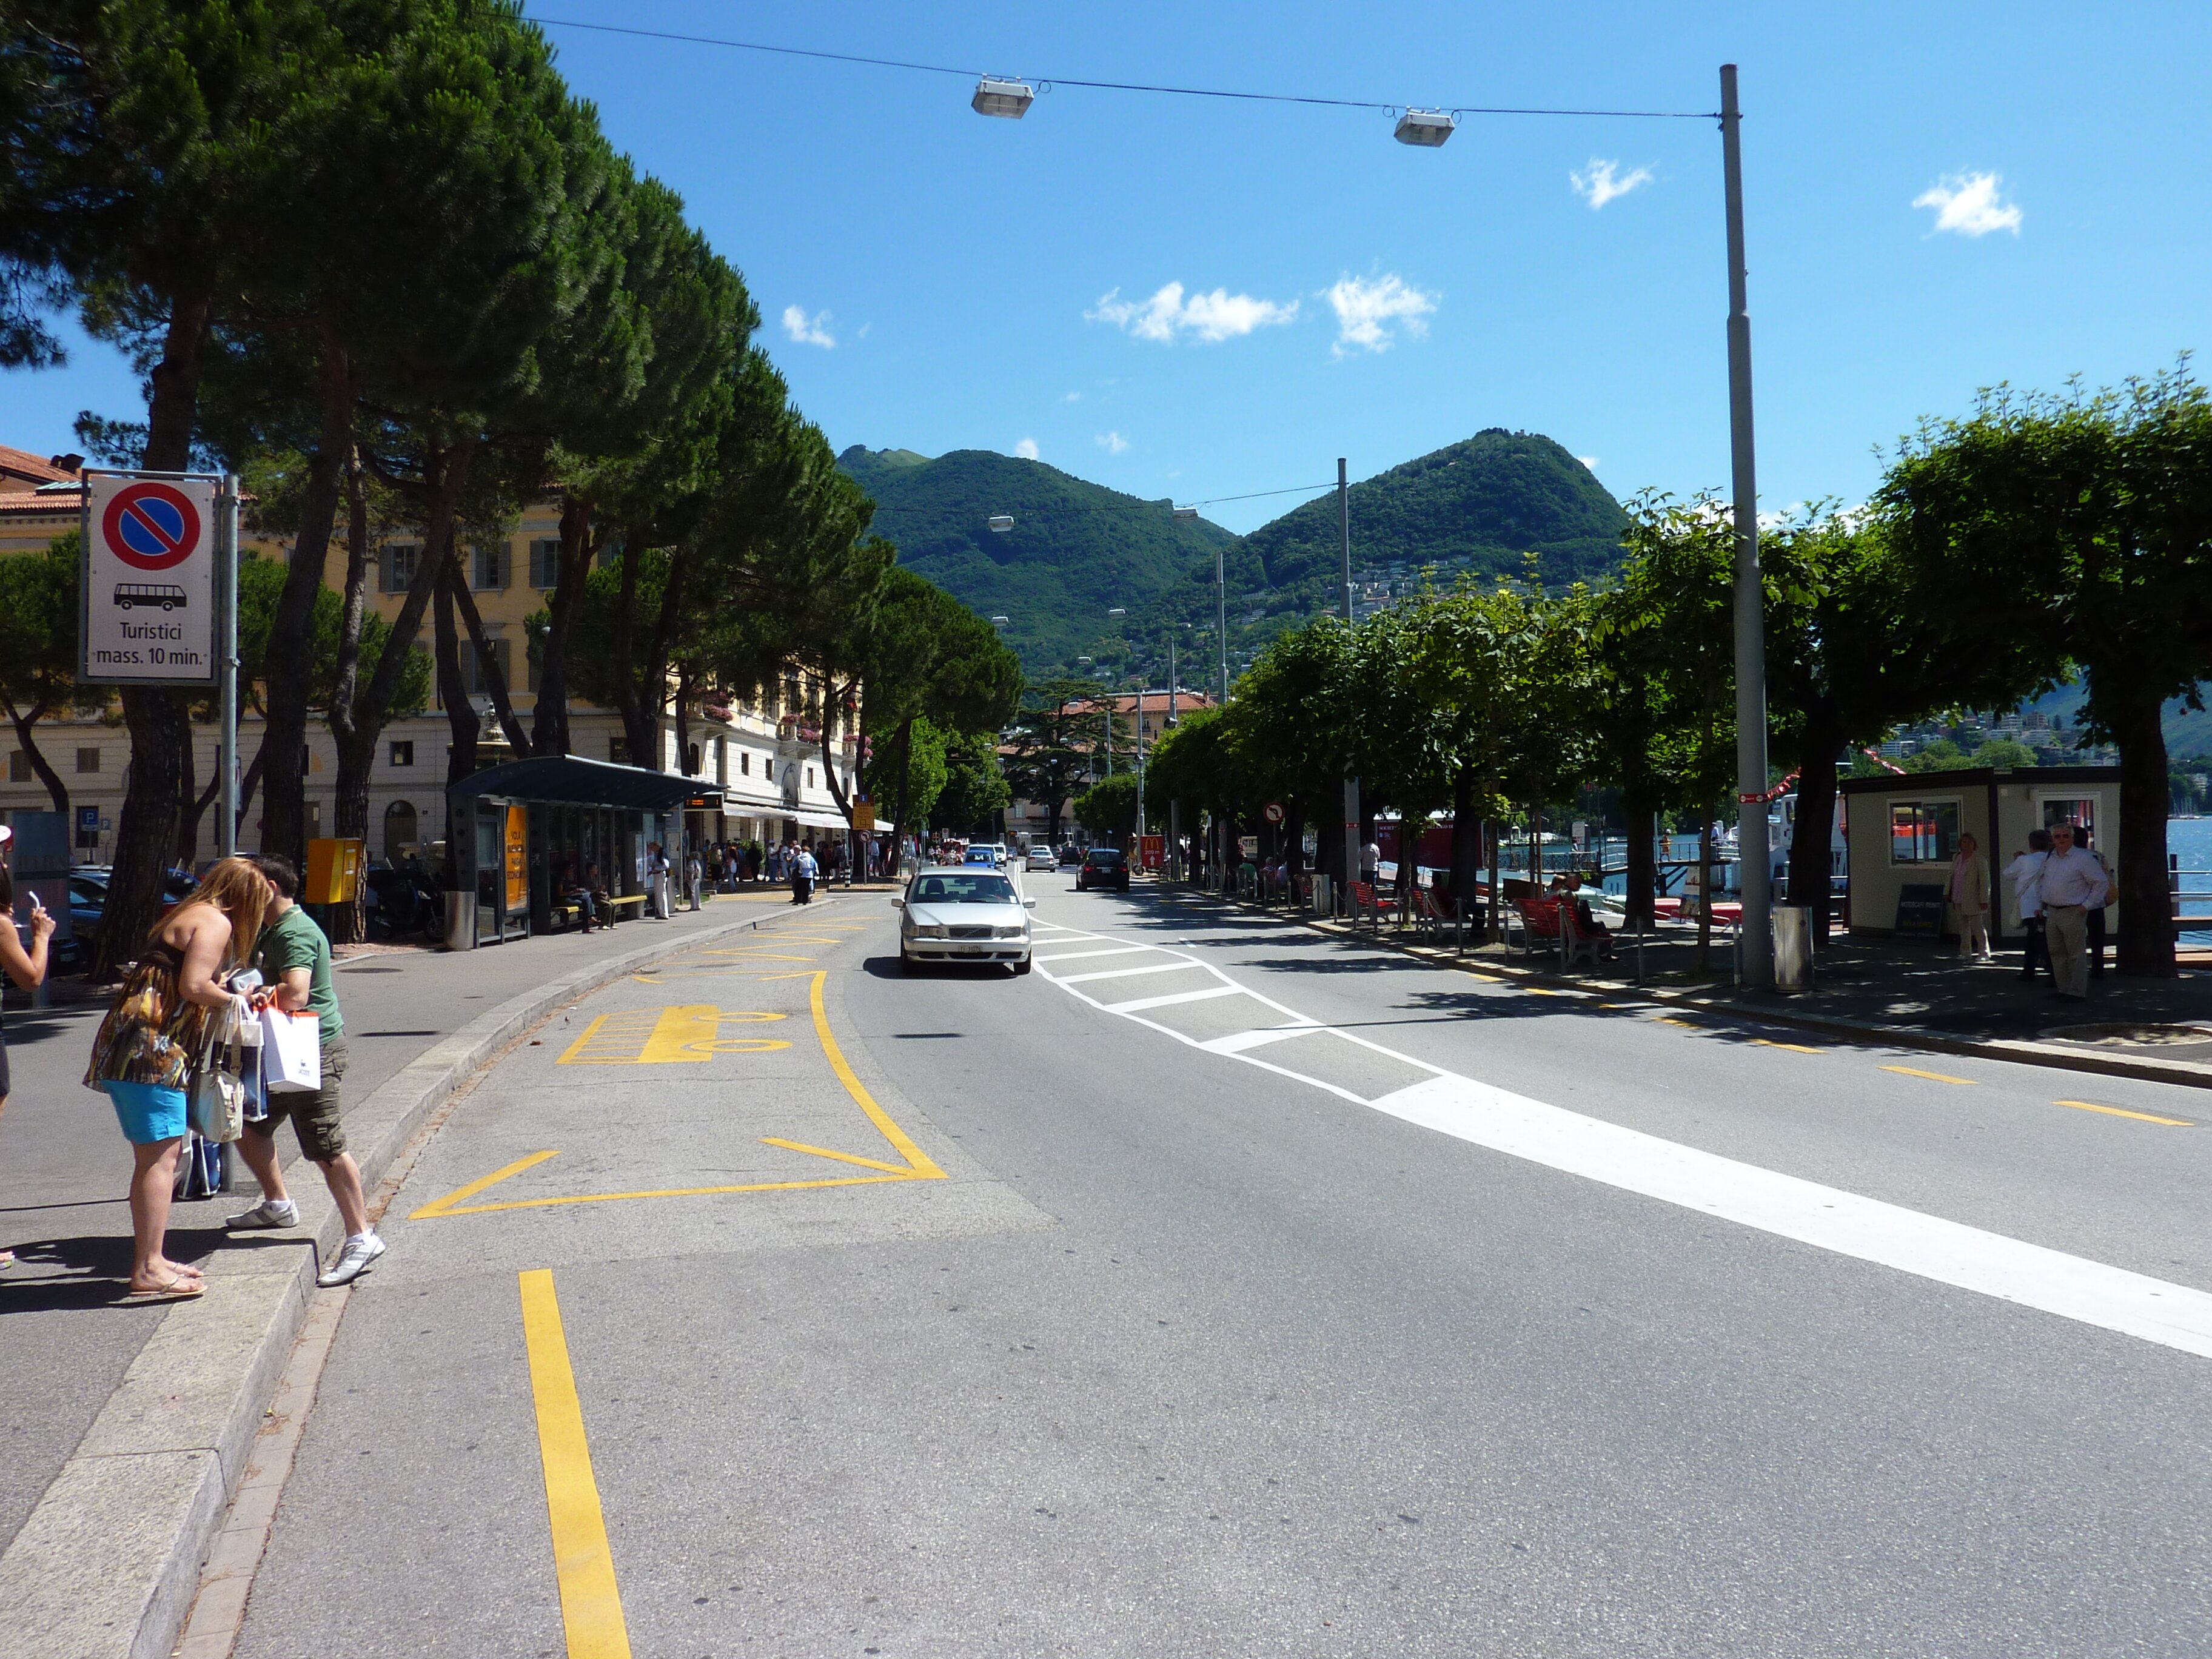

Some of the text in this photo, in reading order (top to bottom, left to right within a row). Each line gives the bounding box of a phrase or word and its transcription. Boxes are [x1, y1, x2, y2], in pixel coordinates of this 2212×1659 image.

[120, 622, 181, 640] Turistici
[97, 648, 203, 665] mass. 10 min.
[87, 812, 94, 823] P
